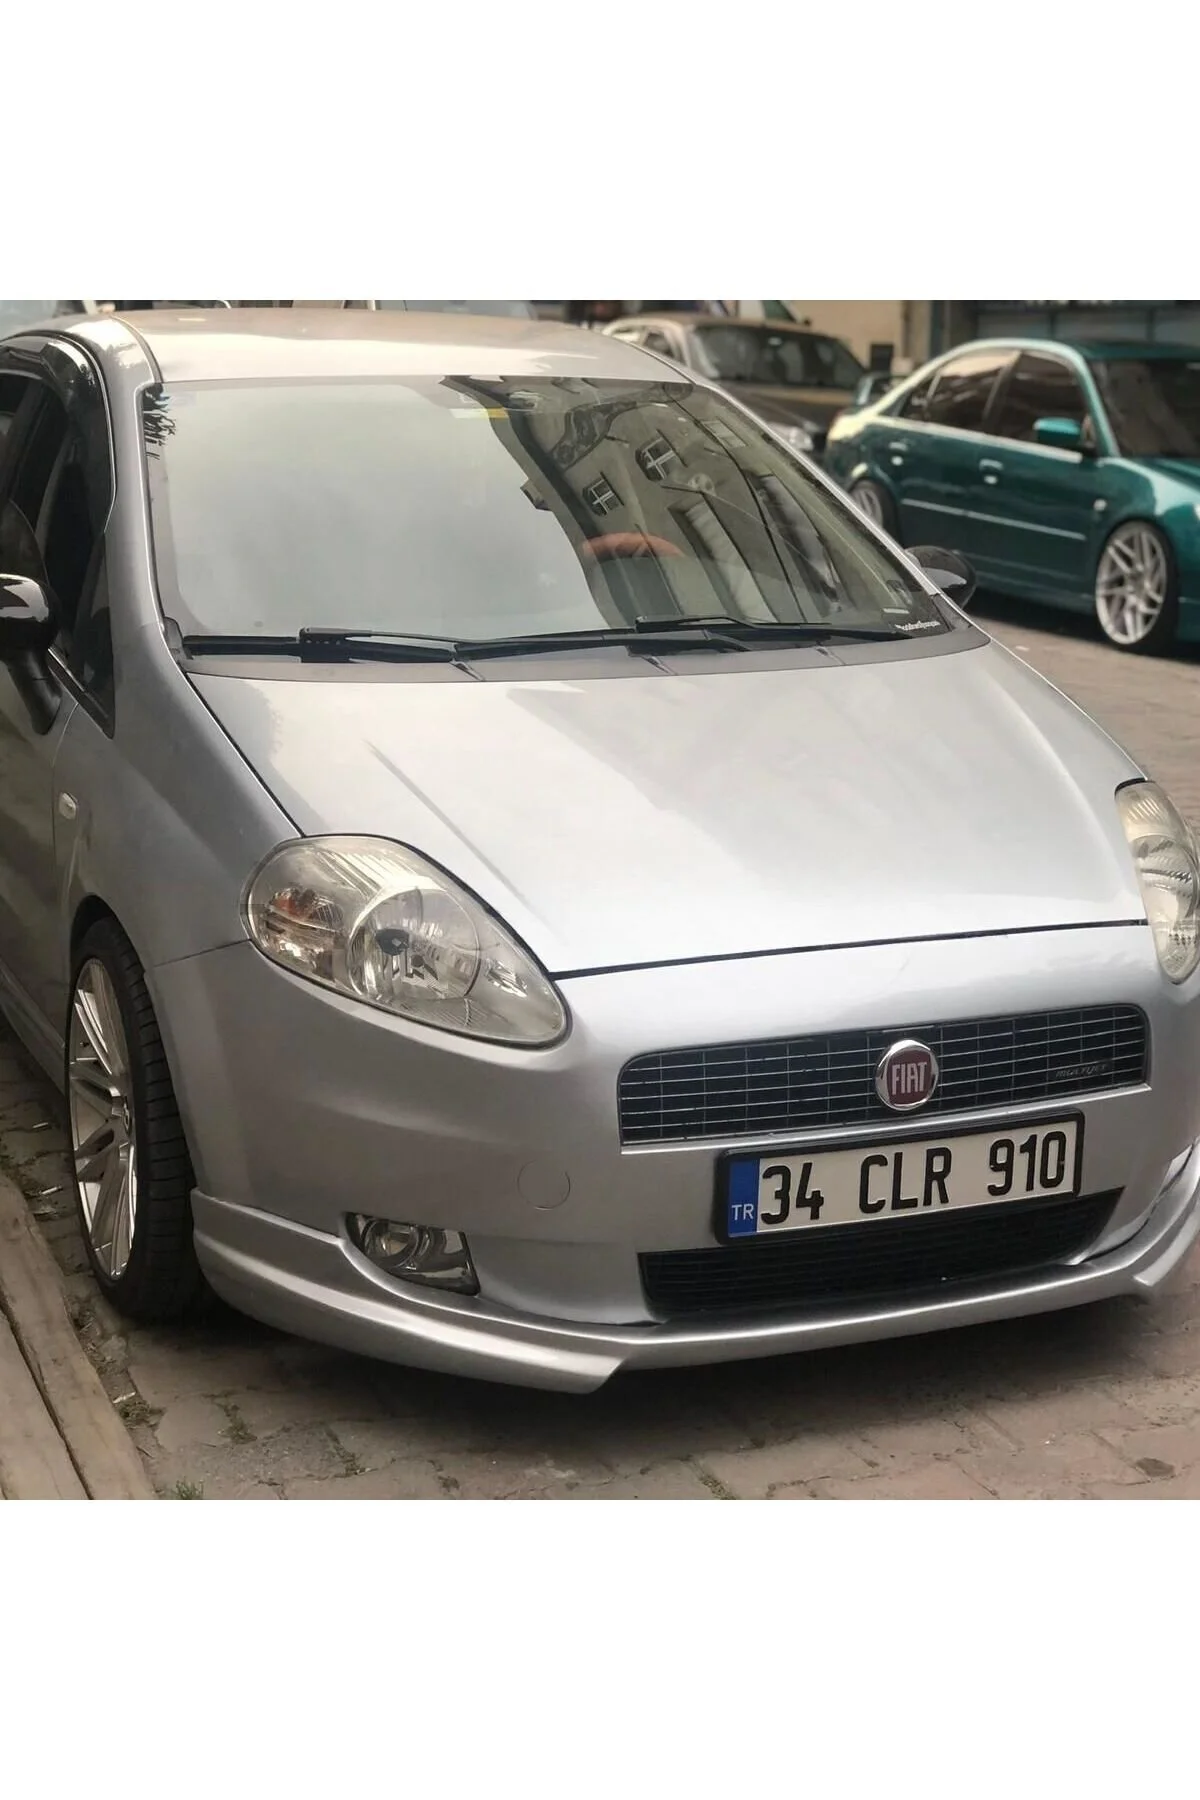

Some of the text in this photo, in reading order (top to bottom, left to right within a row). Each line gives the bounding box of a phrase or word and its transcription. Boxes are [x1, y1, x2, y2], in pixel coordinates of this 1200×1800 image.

[892, 1062, 927, 1095] FIAT
[761, 1131, 1067, 1225] 34 CLR 910
[731, 1204, 755, 1220] TR
